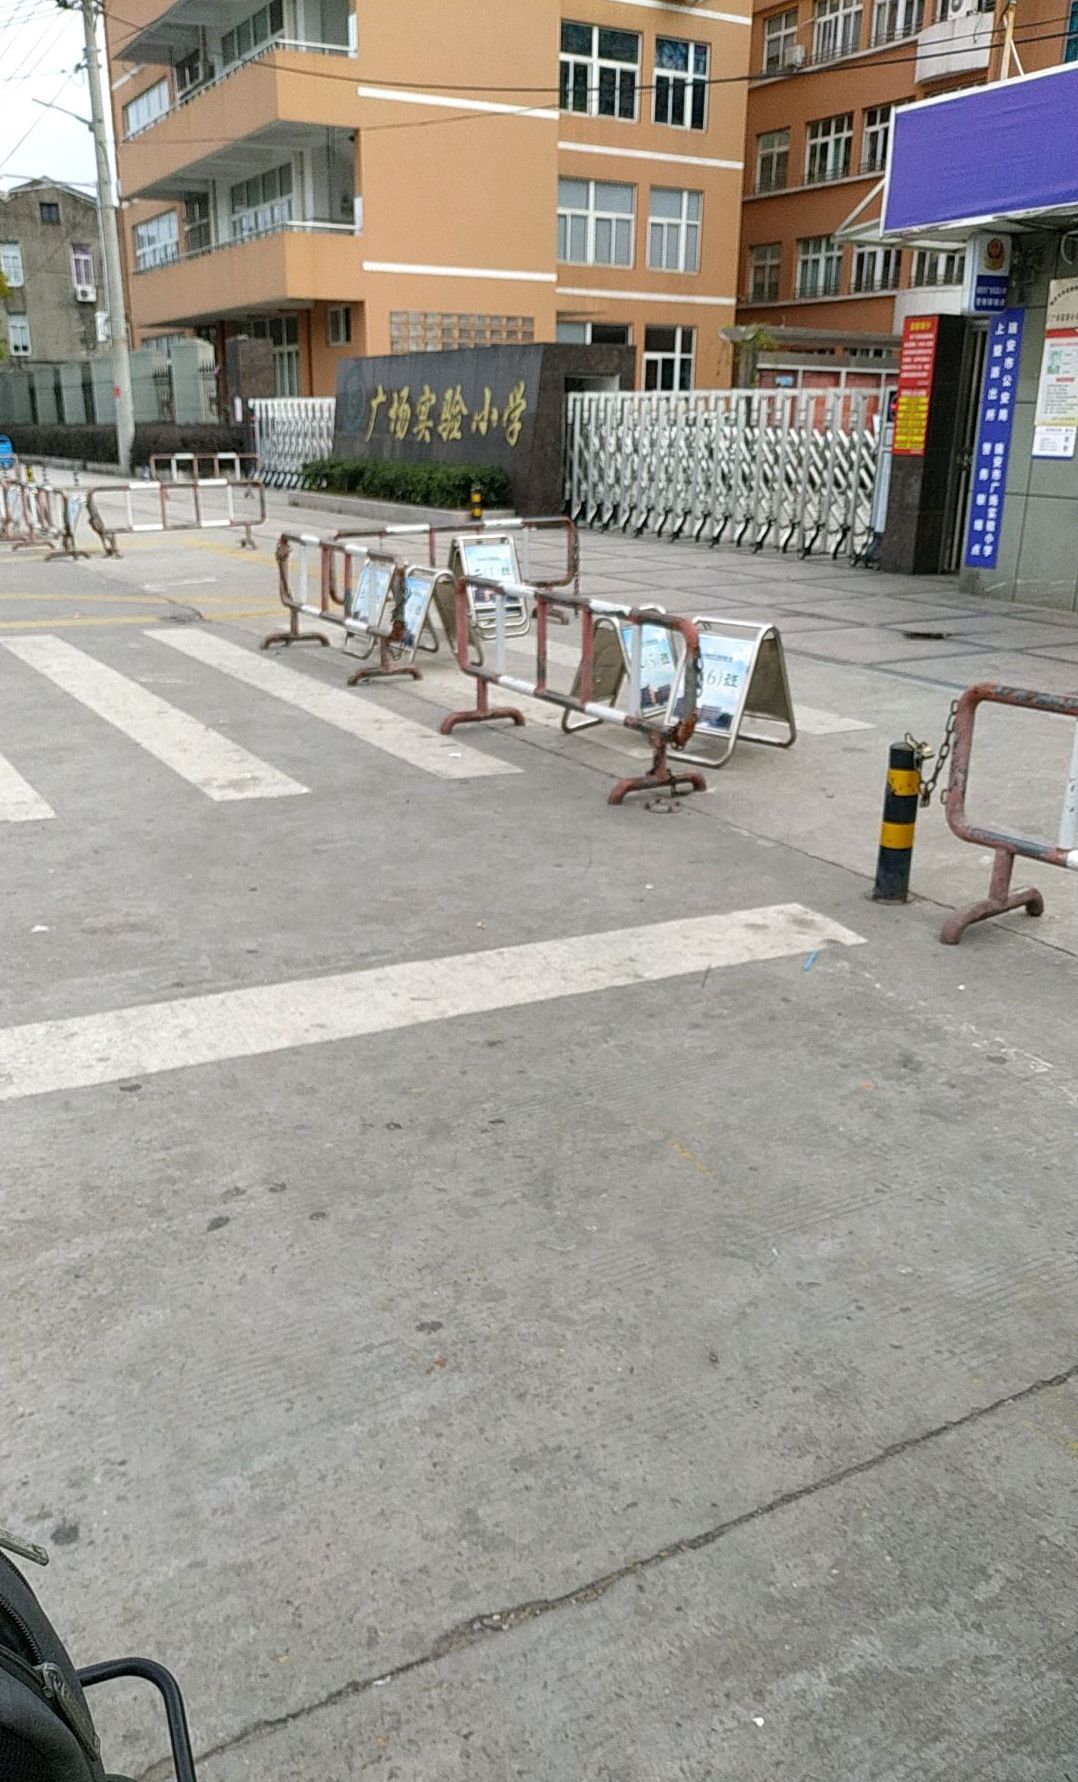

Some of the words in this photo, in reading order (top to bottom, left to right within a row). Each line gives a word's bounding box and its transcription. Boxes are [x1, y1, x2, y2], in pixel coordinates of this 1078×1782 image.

[365, 379, 527, 447] 广场实验小学
[997, 321, 1018, 422] 瑞安市公安局
[982, 442, 1005, 557] 瑞安市广场实验小学
